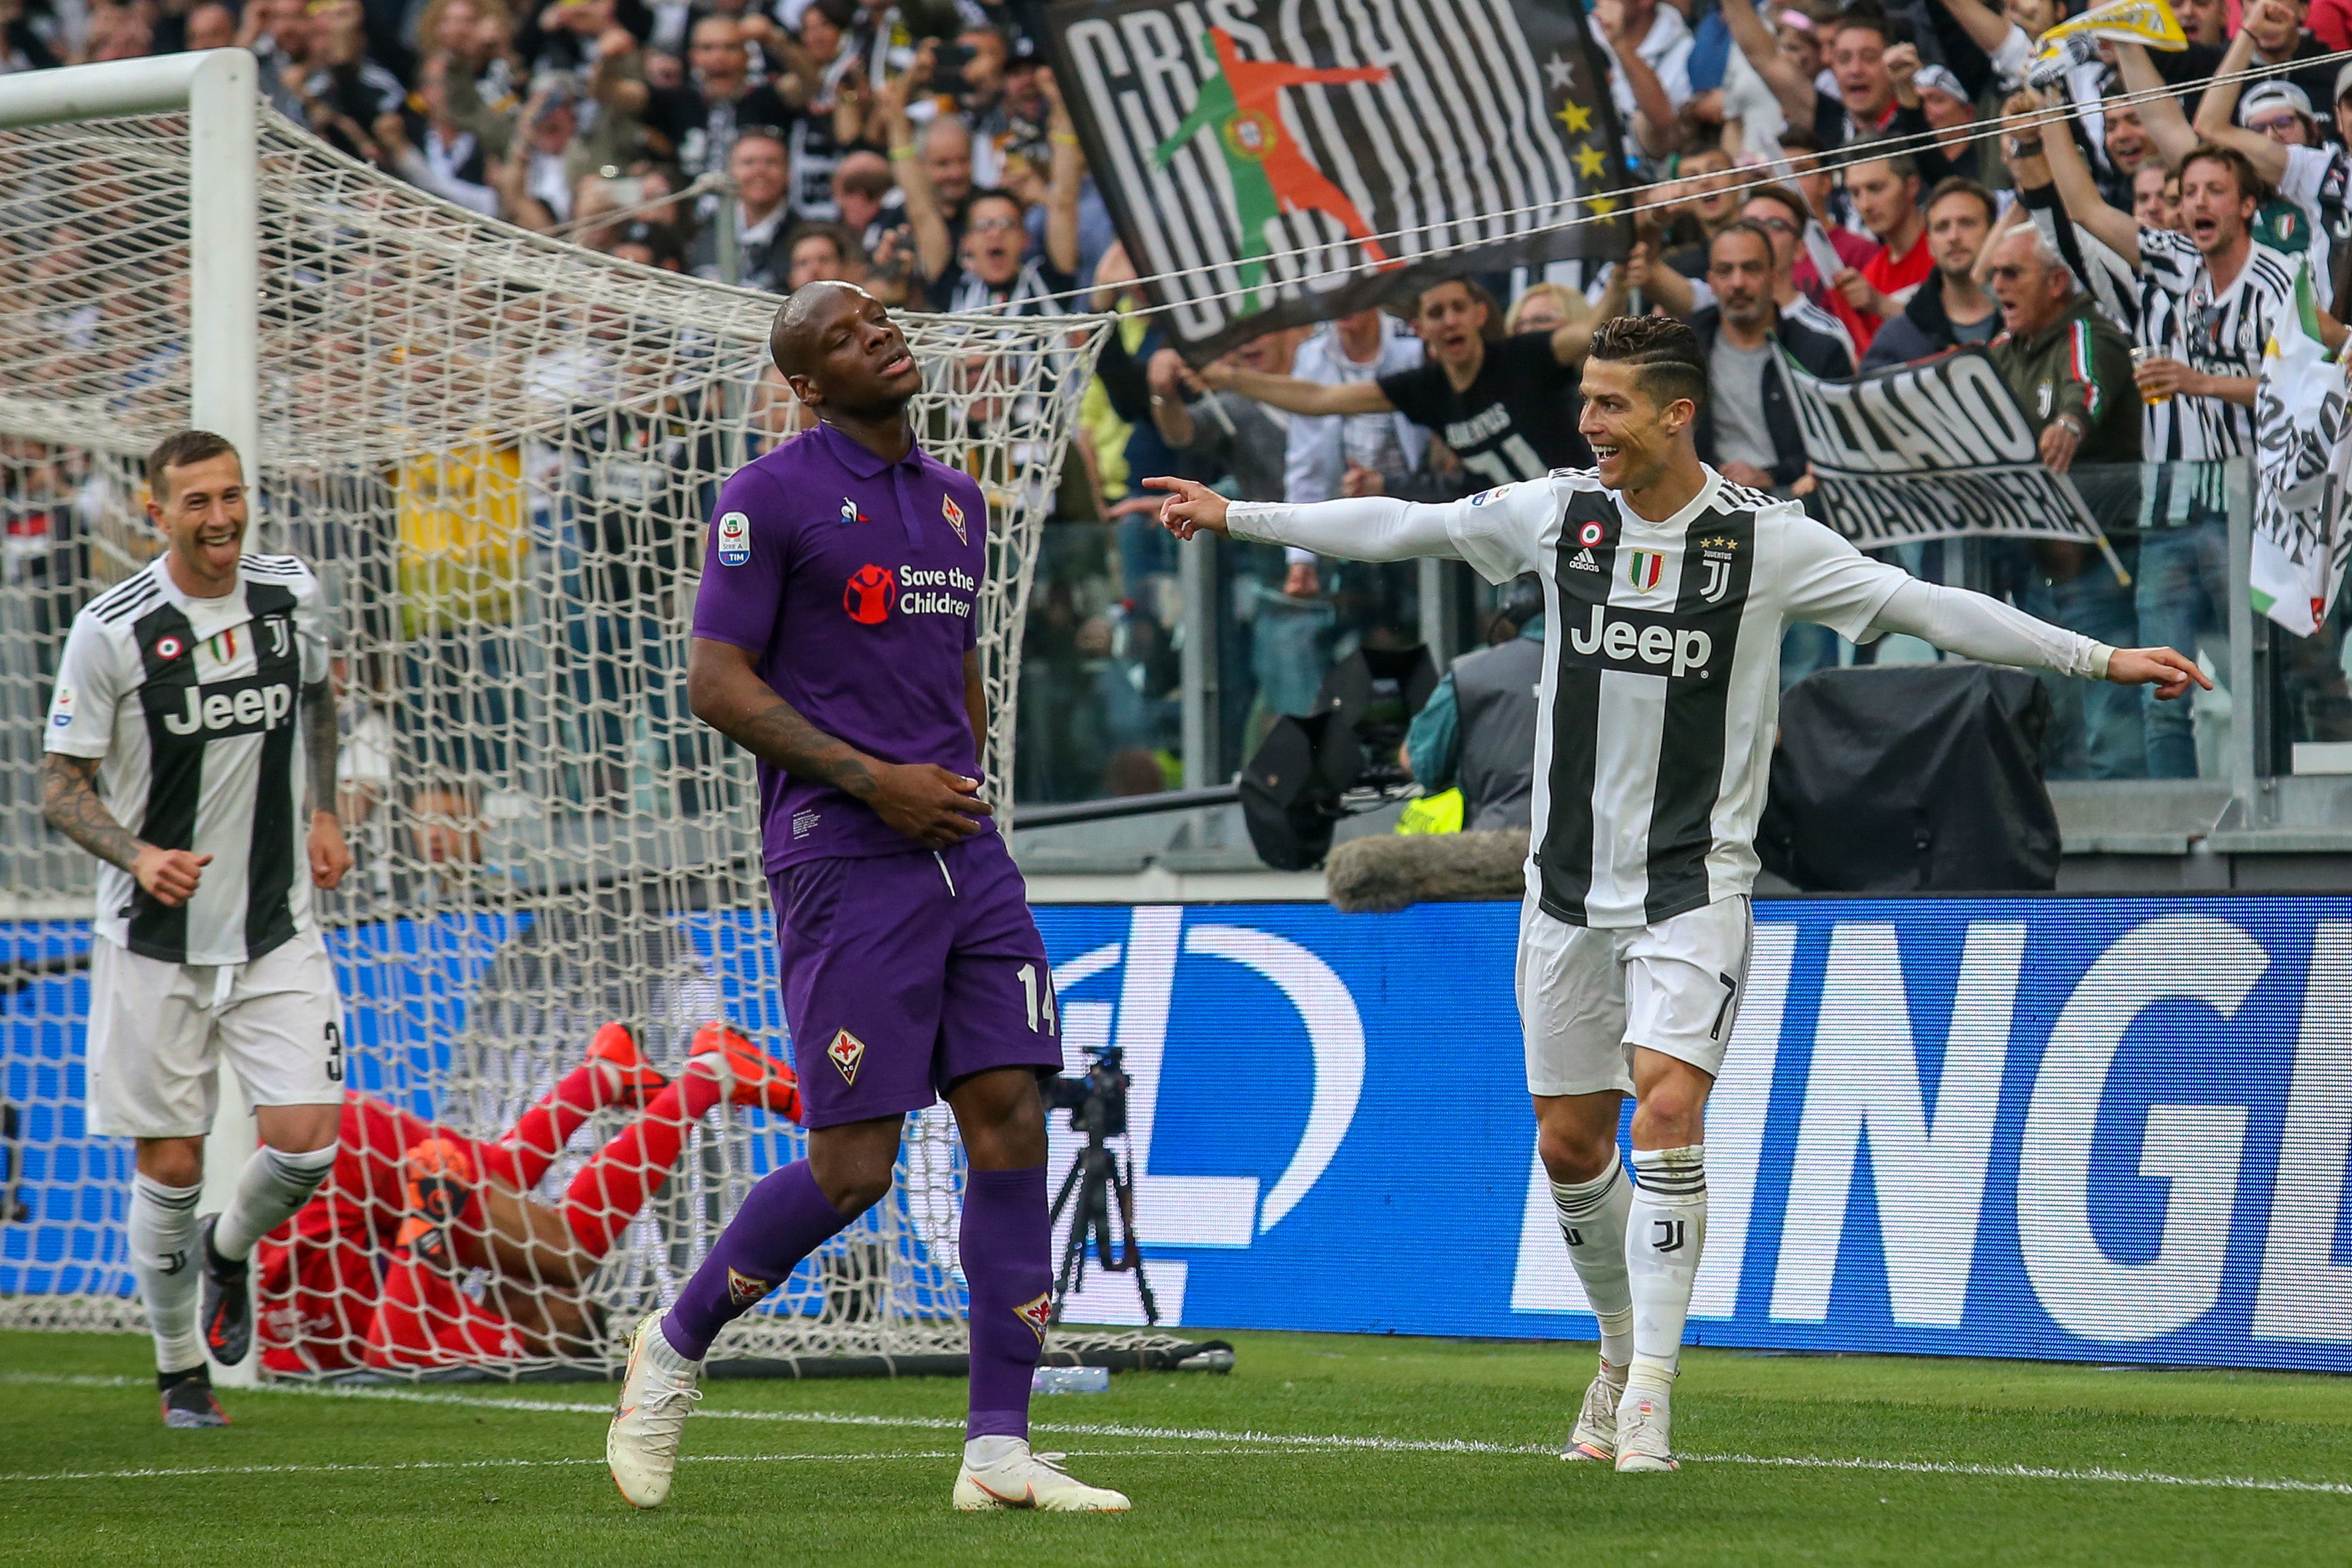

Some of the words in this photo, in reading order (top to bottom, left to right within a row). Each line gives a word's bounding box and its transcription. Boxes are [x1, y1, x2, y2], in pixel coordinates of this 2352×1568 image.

[900, 565, 947, 588] Save
[949, 567, 975, 591] the
[1569, 560, 1600, 573] adidas
[1703, 550, 1733, 560] JUVENTUS
[900, 593, 971, 619] Children
[1570, 604, 1713, 677] Jeep
[163, 683, 292, 735] Jeep
[1016, 963, 1056, 1037] 14
[1710, 973, 1737, 1041] 7
[324, 1022, 343, 1081] 3
